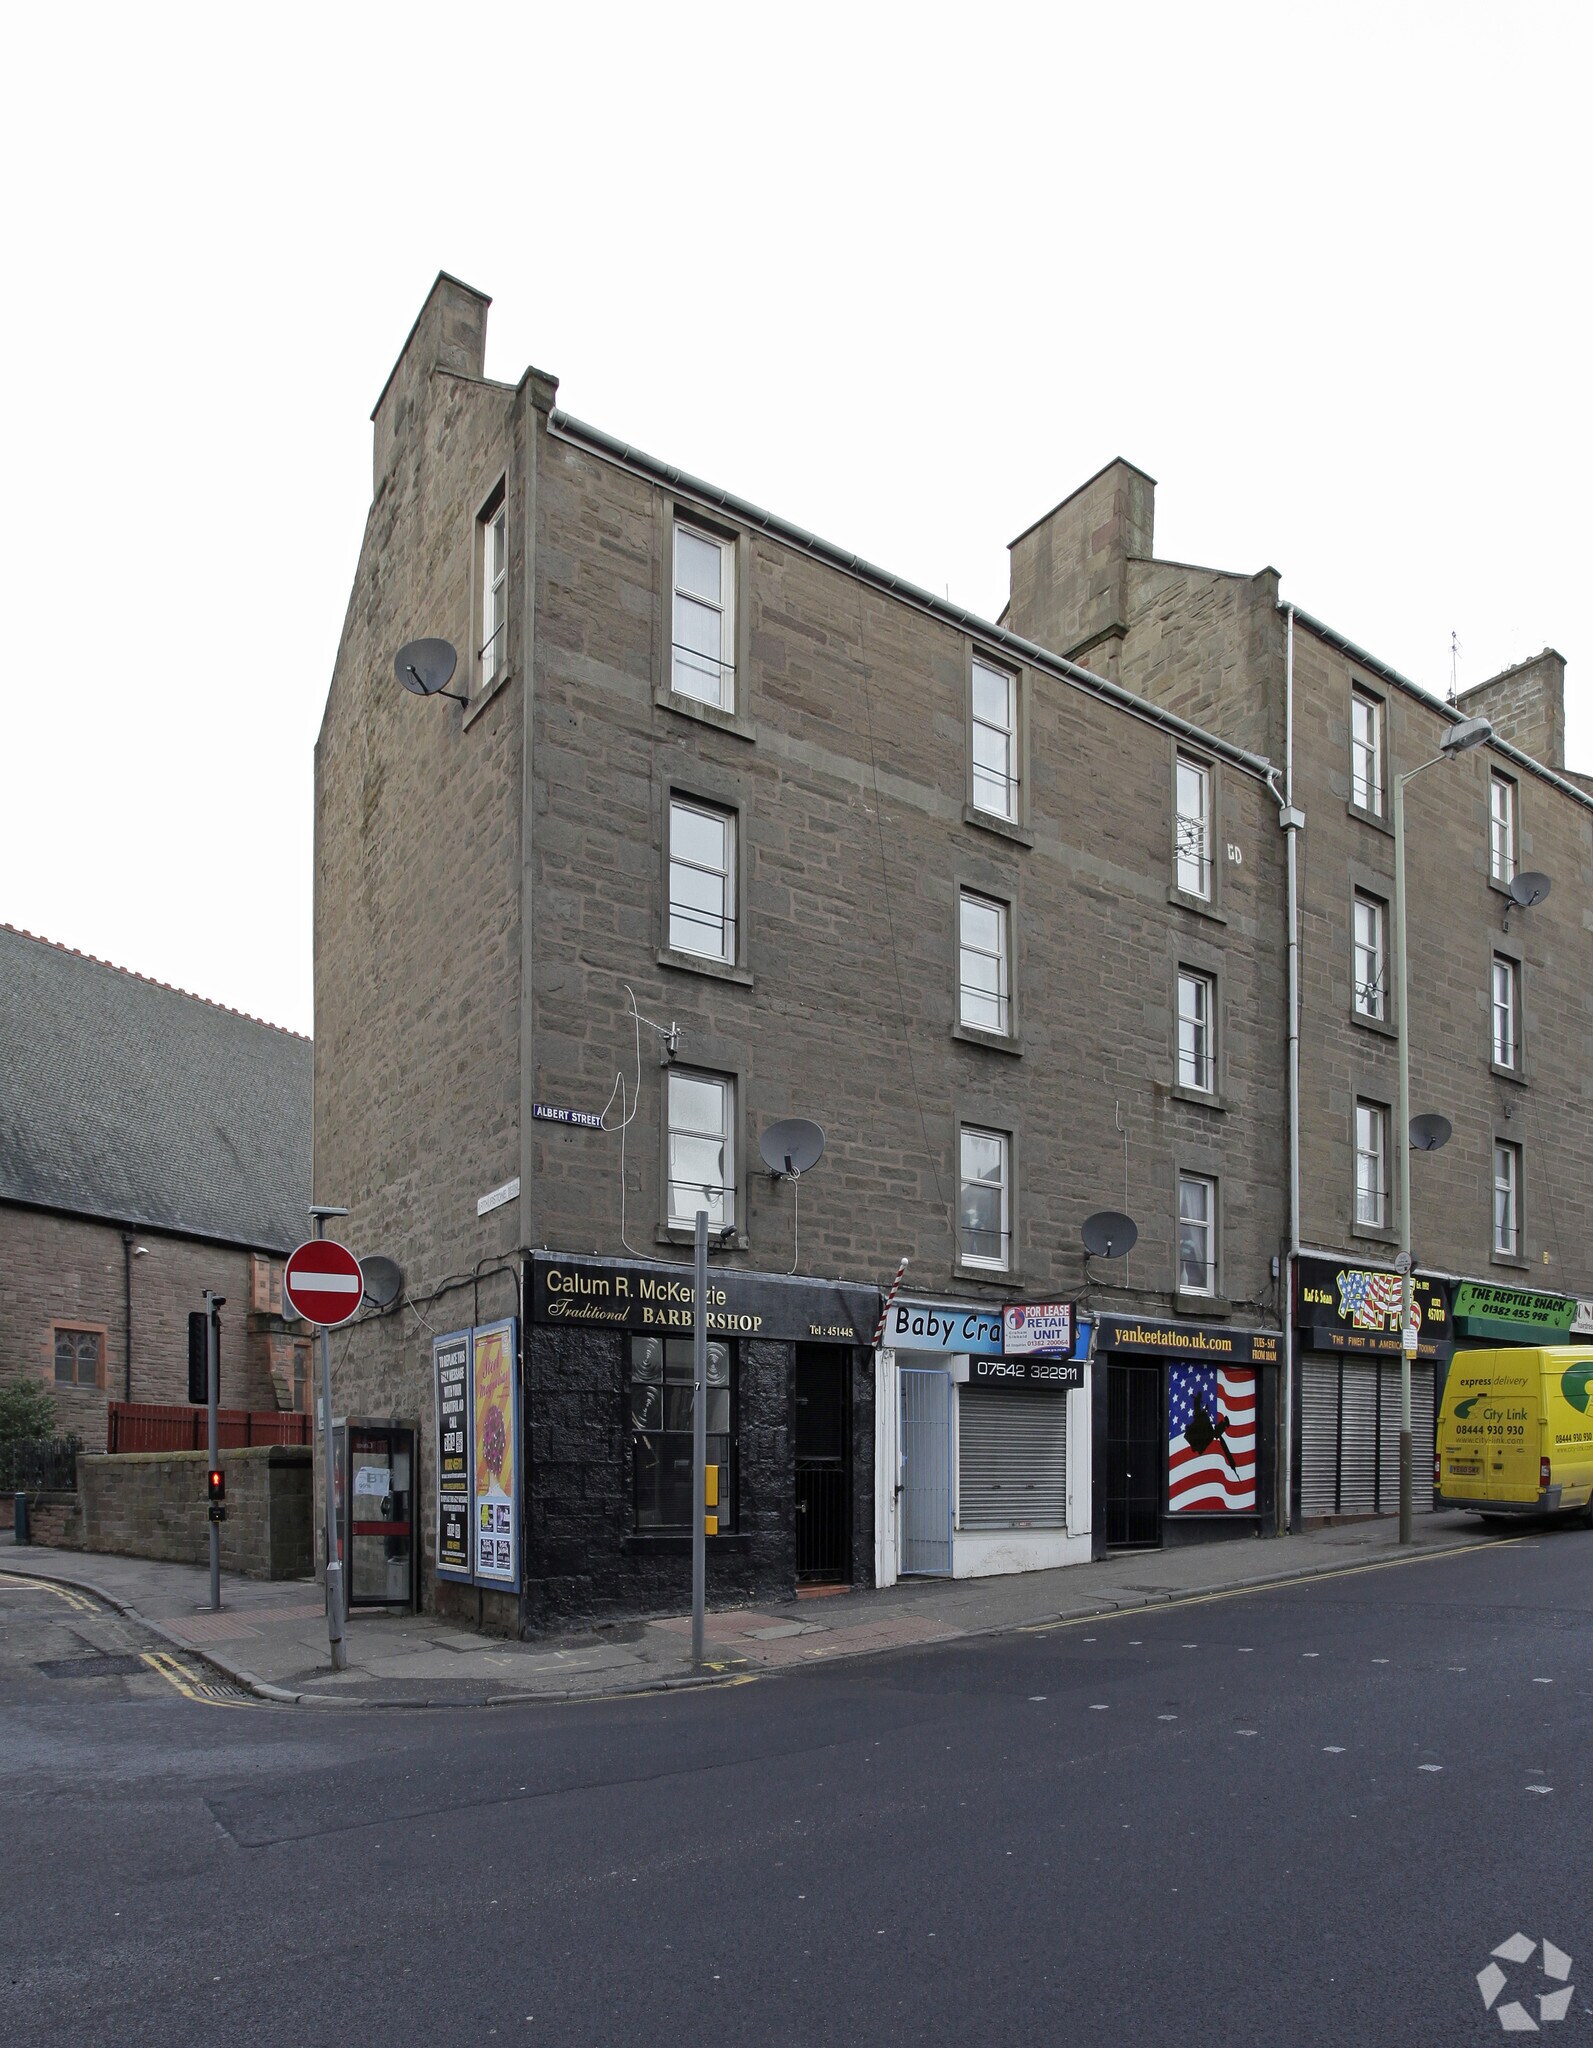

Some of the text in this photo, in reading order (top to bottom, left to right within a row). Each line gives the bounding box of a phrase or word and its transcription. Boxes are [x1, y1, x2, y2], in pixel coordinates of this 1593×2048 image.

[537, 1106, 600, 1126] ALBERT STREET
[546, 1270, 609, 1295] Calum
[615, 1276, 634, 1297] R.
[1471, 1287, 1567, 1312] THE REPTILE SHACK
[547, 1298, 762, 1331] Traditional BARBRSHOP
[1025, 1305, 1069, 1317] FOR LEASE
[1482, 1304, 1510, 1314] 01382
[1512, 1309, 1530, 1319] 455
[1532, 1311, 1550, 1321] 998
[896, 1306, 1000, 1345] Baby Cra
[1027, 1317, 1068, 1328] RETAIL
[827, 1326, 853, 1337] 451445
[1033, 1329, 1062, 1340] UNIT
[1115, 1325, 1232, 1351] yankeetattoo.uk.com
[1348, 1336, 1365, 1347] FINEST
[1369, 1338, 1376, 1348] IN
[1252, 1350, 1265, 1360] FROM
[977, 1361, 1077, 1380] 07542 322911
[694, 1381, 700, 1391] 7
[1460, 1375, 1528, 1388] express delivery
[1483, 1407, 1528, 1423] City Link
[1456, 1425, 1524, 1435] 08444 930 930
[1456, 1436, 1524, 1446] www.city-link.com
[1555, 1431, 1593, 1444] 08444 930 930
[366, 1472, 388, 1484] BT
